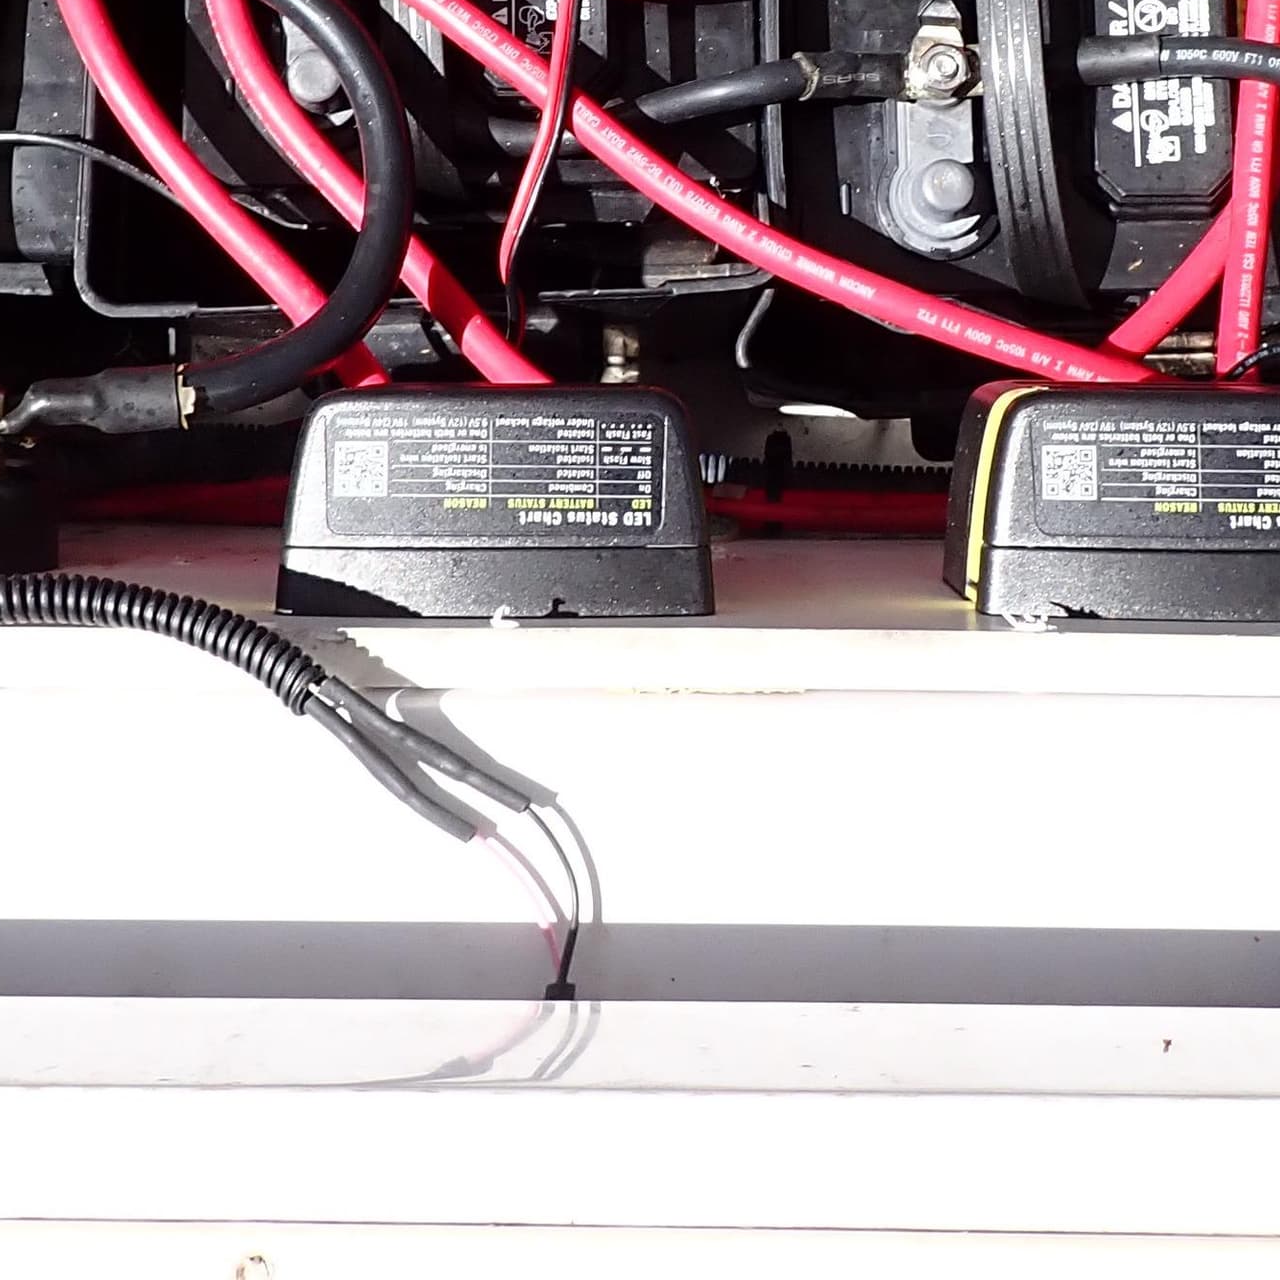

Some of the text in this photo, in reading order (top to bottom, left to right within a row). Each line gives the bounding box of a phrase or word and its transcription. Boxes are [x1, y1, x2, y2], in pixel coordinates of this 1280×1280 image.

[1213, 50, 1239, 62] 600V
[1244, 53, 1262, 66] FT1
[1253, 114, 1267, 136] AWM
[1251, 141, 1264, 153] OR
[1250, 158, 1263, 173] FT1
[1248, 176, 1261, 198] 600V
[1244, 232, 1257, 249] TEW
[760, 235, 793, 261] GRADE
[1242, 254, 1255, 270] CSA
[838, 276, 877, 299] ANCOR
[915, 307, 1094, 381] AWM A/B 600V FT1 FT2
[532, 416, 595, 428] Under voltage
[1120, 421, 1196, 432] 9.5V (12V System)
[1239, 422, 1270, 432] voltage
[1202, 423, 1237, 433] lockout
[469, 429, 488, 439] One
[557, 430, 594, 439] Isolated
[605, 430, 651, 440] Fast Flash
[1098, 433, 1196, 442] One or both batteries
[528, 444, 594, 454] Start isolation
[1140, 448, 1185, 457] energised
[1236, 450, 1275, 458] isolation
[464, 454, 487, 464] Start
[557, 455, 594, 464] Isolated
[603, 455, 651, 465] Slow Flash
[1130, 459, 1196, 468] Start isolation
[432, 467, 487, 479] Discharging
[557, 469, 594, 479] Isolated
[637, 470, 651, 480] Off
[1141, 472, 1196, 482] Discharging
[445, 480, 487, 492] Charging
[549, 483, 594, 493] Combined
[639, 484, 651, 494] On
[1155, 486, 1197, 496] Charging
[443, 498, 487, 508] REASON
[507, 498, 594, 509] BATTERY STATUS
[631, 499, 652, 509] LED
[1154, 502, 1197, 512] REASON
[1218, 502, 1256, 513] STATUS
[519, 511, 651, 526] LED Status Chart
[1229, 515, 1272, 529] Chart
